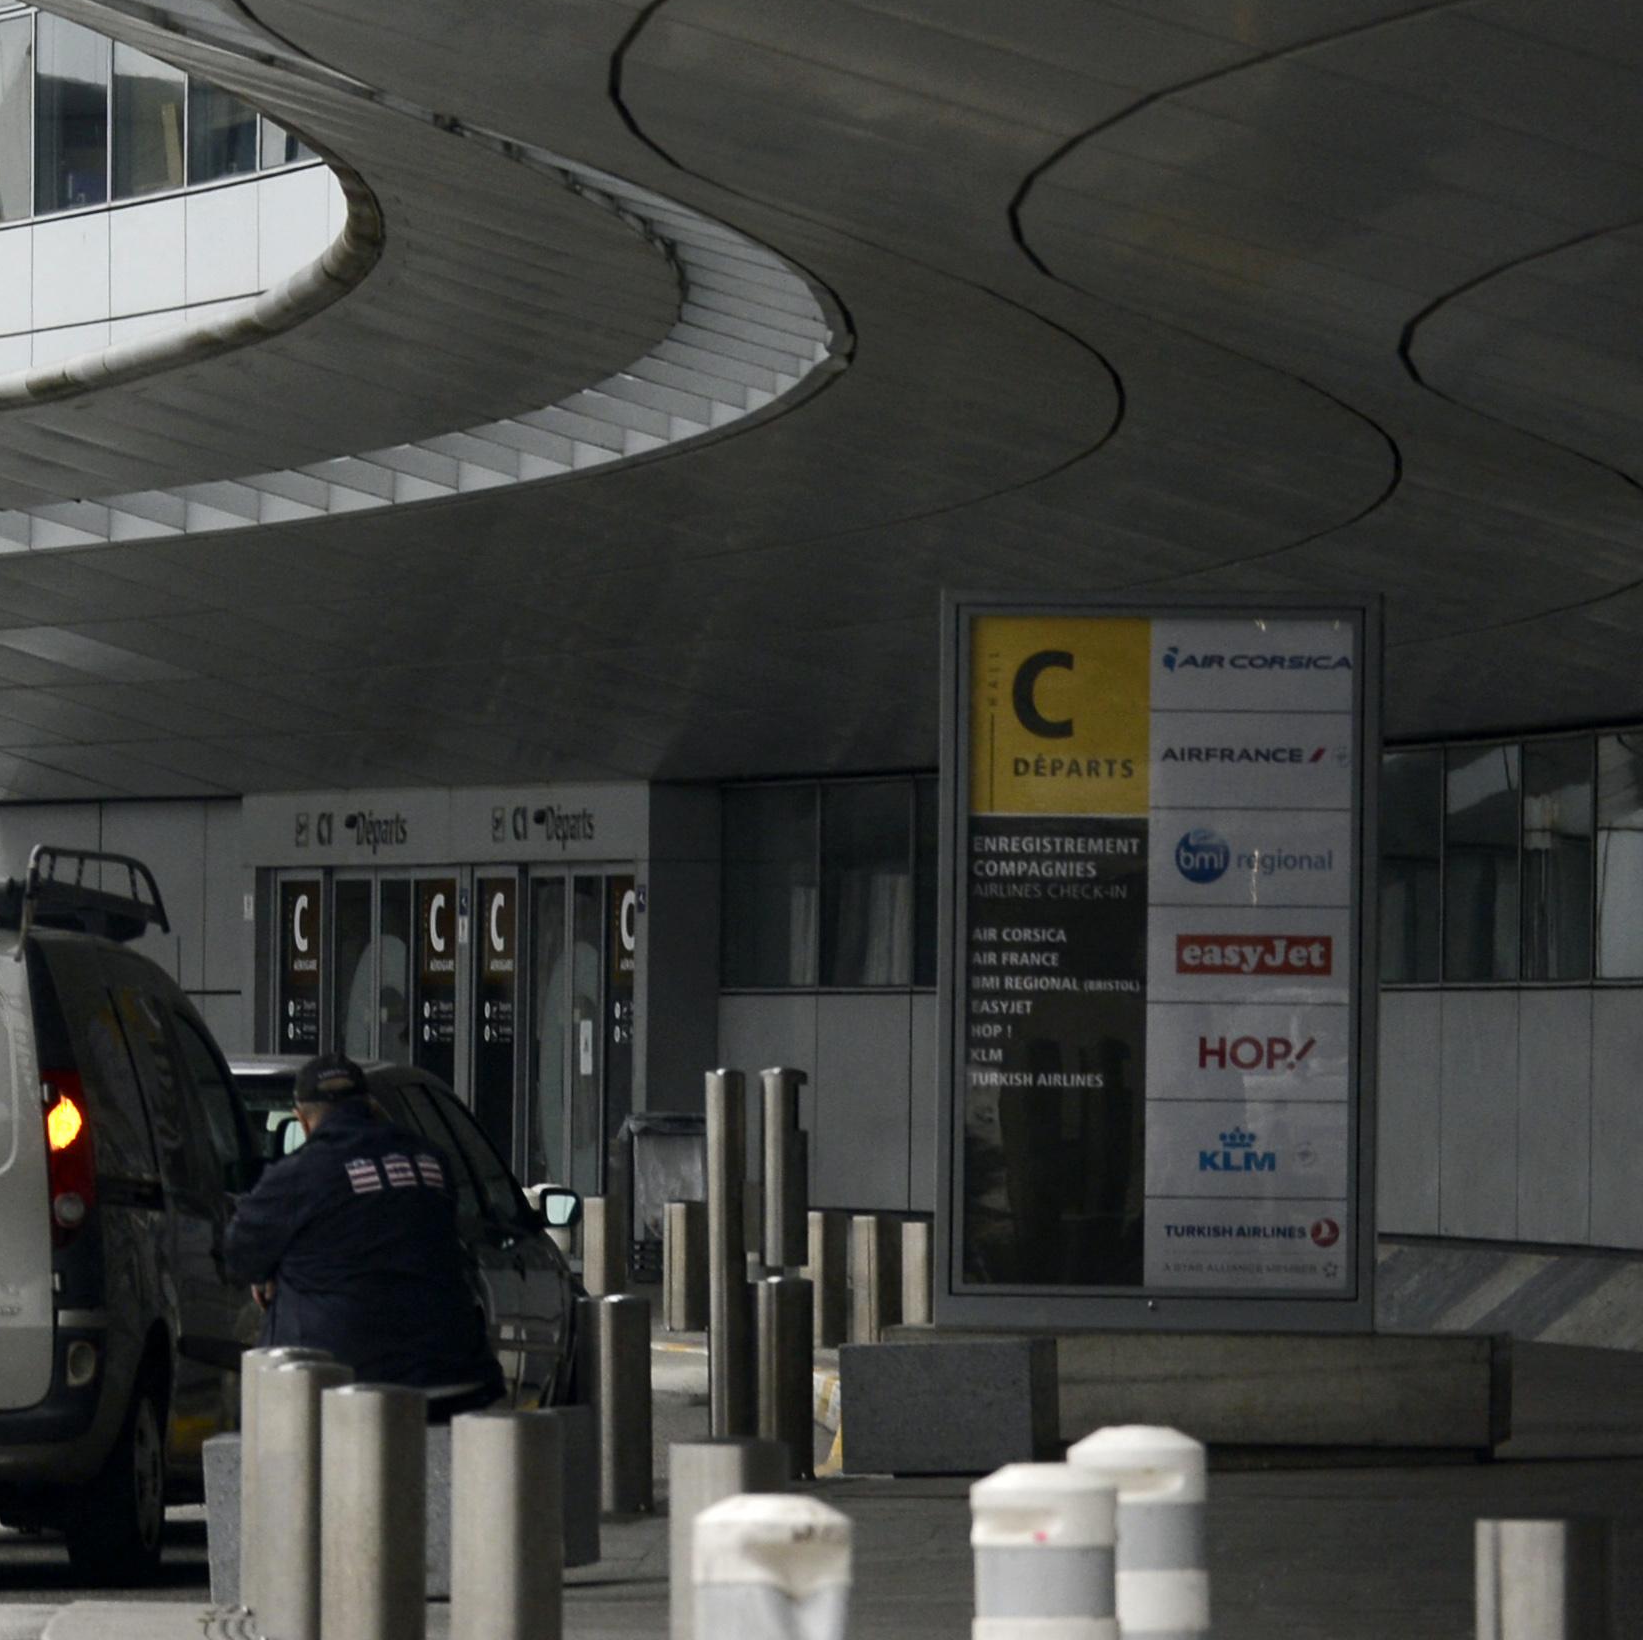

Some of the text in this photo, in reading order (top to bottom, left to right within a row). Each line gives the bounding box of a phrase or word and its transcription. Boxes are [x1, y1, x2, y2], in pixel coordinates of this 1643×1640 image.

[1178, 653, 1353, 670] AIR CORSICA
[1012, 649, 1075, 739] C
[1012, 752, 1135, 779] DÉPARTS
[972, 835, 1141, 855] ENREGISTREMENT
[972, 860, 1098, 879] COMPAGNIES
[1178, 847, 1333, 875] bmi regional
[972, 882, 1128, 900] AIRLINES CHECK-IN
[293, 893, 309, 953] C
[429, 892, 446, 953] C
[490, 892, 505, 953] C
[972, 927, 1068, 943] AIR CORSICA
[972, 951, 1060, 967] AIR FRANCE
[1182, 939, 1326, 972] easyJet
[971, 975, 1001, 991] BMI
[1004, 975, 1081, 992] REGIONAL
[971, 1000, 1034, 1015] EASYJET
[971, 1024, 1002, 1039] HOP
[970, 1048, 1004, 1063] KLM
[971, 1071, 1105, 1088] TURKISH AIRLINES
[1199, 1150, 1277, 1172] KLM
[1164, 1223, 1307, 1240] TURKISH AIRLINES
